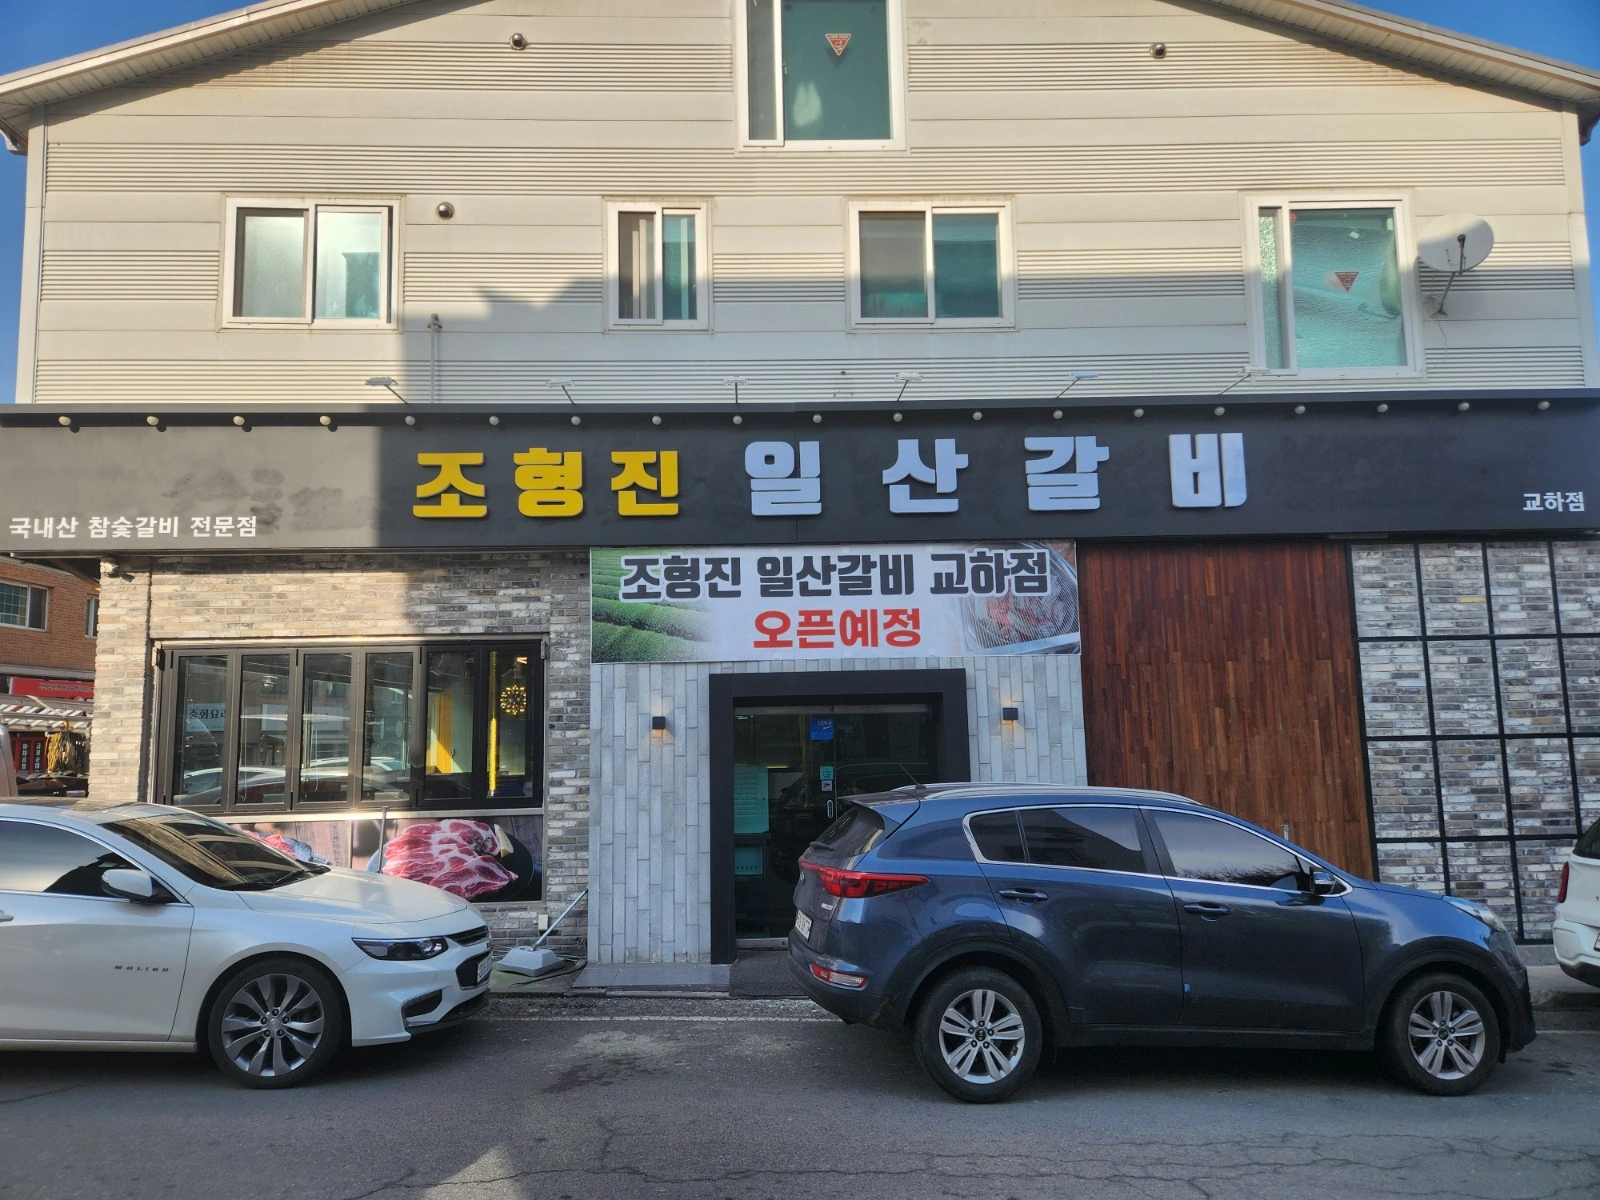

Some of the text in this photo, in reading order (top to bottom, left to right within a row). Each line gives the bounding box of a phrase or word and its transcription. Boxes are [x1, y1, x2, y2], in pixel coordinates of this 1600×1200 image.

[412, 431, 1248, 519] 조형진 일산갈비
[1522, 491, 1585, 512] 교하점
[9, 514, 257, 539] 국내산 참숯갈비 전문점
[621, 550, 1048, 599] 조형진 일산갈비 교하점
[753, 608, 921, 649] 오픈예정
